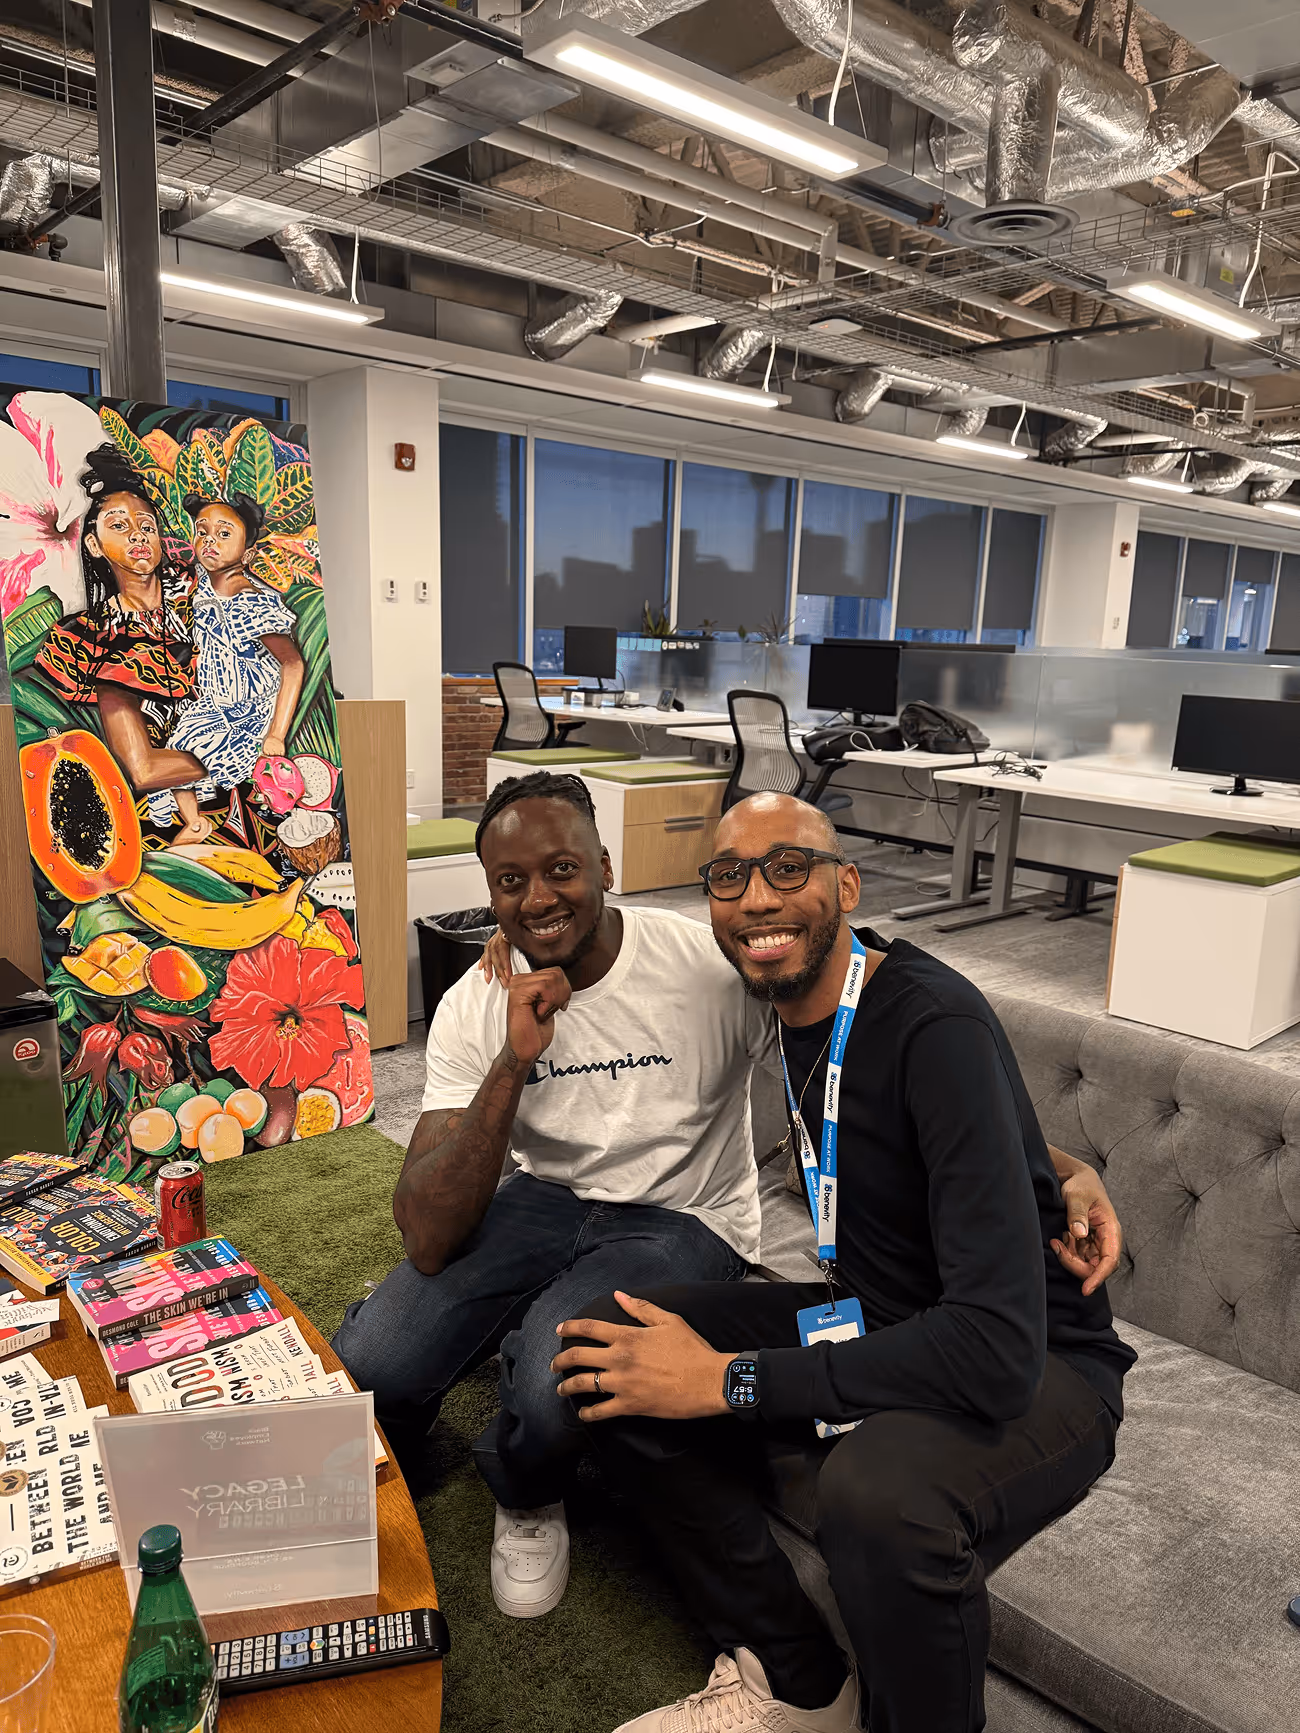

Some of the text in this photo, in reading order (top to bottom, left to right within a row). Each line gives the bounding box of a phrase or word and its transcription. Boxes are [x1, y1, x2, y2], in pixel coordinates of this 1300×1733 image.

[846, 968, 859, 998] benevity
[838, 1011, 848, 1036] PURPOSE
[823, 1192, 831, 1222] benevity
[50, 1221, 101, 1253] COLOR
[79, 1214, 121, 1242] EMOTIONAL
[204, 1242, 220, 1257] COLE
[176, 1265, 207, 1292] WE'RE
[216, 1256, 241, 1278] DESMOND
[104, 1262, 185, 1312] SKIN
[102, 1287, 229, 1336] DESMOND COLE THE SKIN WE'RE IN
[278, 1324, 303, 1357] KENDALL
[2, 1371, 26, 1389] ME
[36, 1425, 59, 1456] RLD
[27, 1468, 54, 1555] BETWEEN
[59, 1454, 89, 1554] THE WORLD
[97, 1491, 113, 1524] AND
